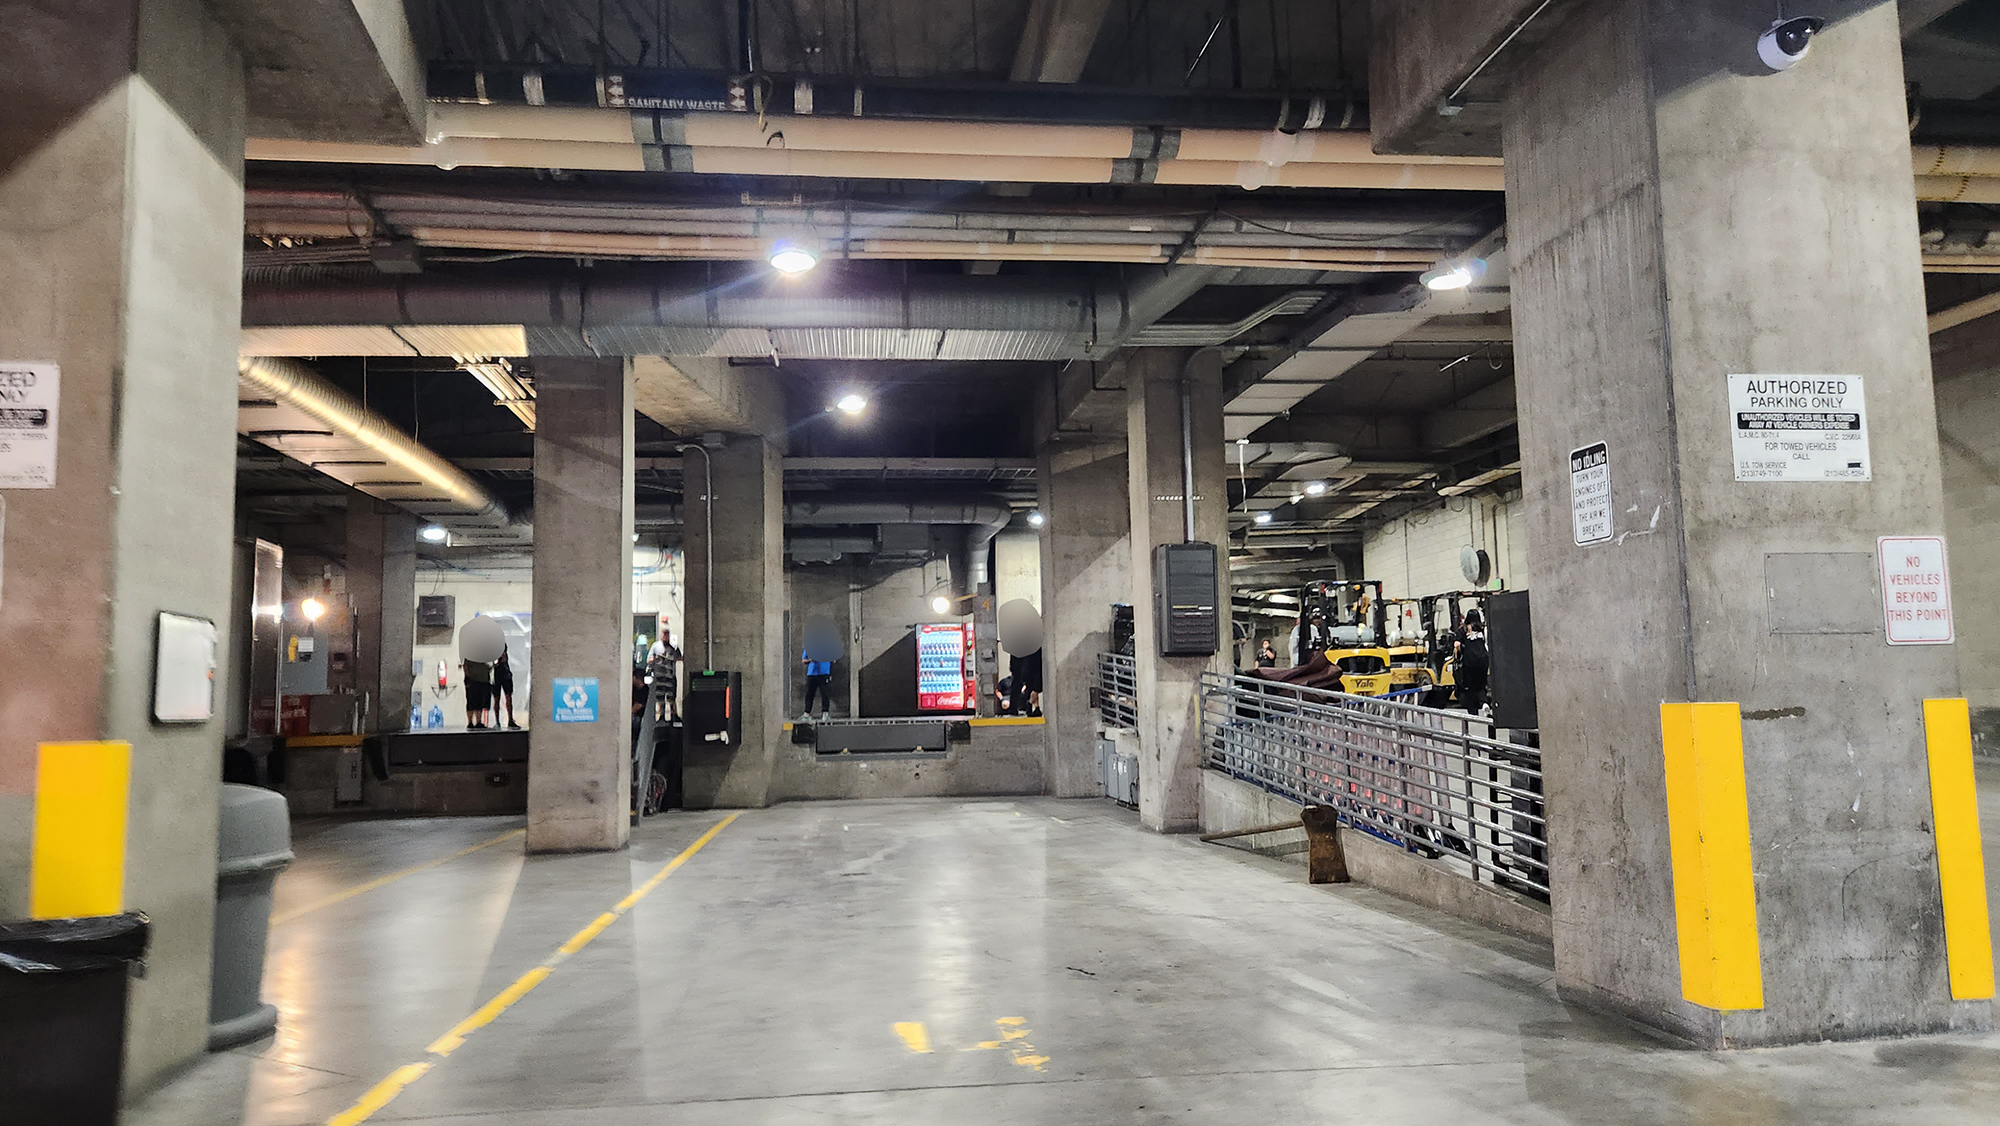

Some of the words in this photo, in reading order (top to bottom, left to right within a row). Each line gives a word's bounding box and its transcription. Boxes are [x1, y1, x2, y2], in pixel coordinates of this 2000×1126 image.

[628, 98, 684, 109] SANITARY
[686, 100, 726, 110] WASTE
[1747, 380, 1847, 394] AUTHORIZED
[1751, 397, 1808, 408] PARKING
[1812, 397, 1843, 408] ONLY
[1741, 413, 1785, 421] UNAUTHORIZED
[1785, 413, 1812, 421] VEHICLES
[1813, 413, 1826, 421] WILL
[1749, 421, 1764, 429] AWAY
[1765, 421, 1772, 429] AT
[1773, 421, 1798, 429] VEHICLE
[1765, 442, 1778, 450] FOR
[1780, 442, 1803, 450] TOWED
[1806, 443, 1837, 451] VEHICLES
[1572, 458, 1582, 471] NO
[1583, 451, 1605, 468] IDLING
[1752, 461, 1763, 469] TOW
[1765, 461, 1787, 469] SERVICE
[1576, 472, 1589, 482] TURN
[1590, 468, 1604, 479] YOUR
[1575, 483, 1596, 497] ENGINES
[1597, 481, 1606, 491] OFF
[1575, 500, 1585, 509] AND
[1586, 495, 1608, 508] PROTECT
[1579, 513, 1588, 522] THE
[1589, 510, 1598, 519] AIR
[1599, 508, 1606, 518] WE
[1582, 523, 1604, 535] BREATHE
[1906, 556, 1920, 567] NO
[1889, 574, 1940, 585] VEHICLES
[1896, 591, 1937, 603] BEYOND
[982, 598, 990, 611] 4
[1889, 609, 1912, 621] THIS
[1917, 609, 1947, 620] POINT
[1355, 679, 1374, 688] Yale
